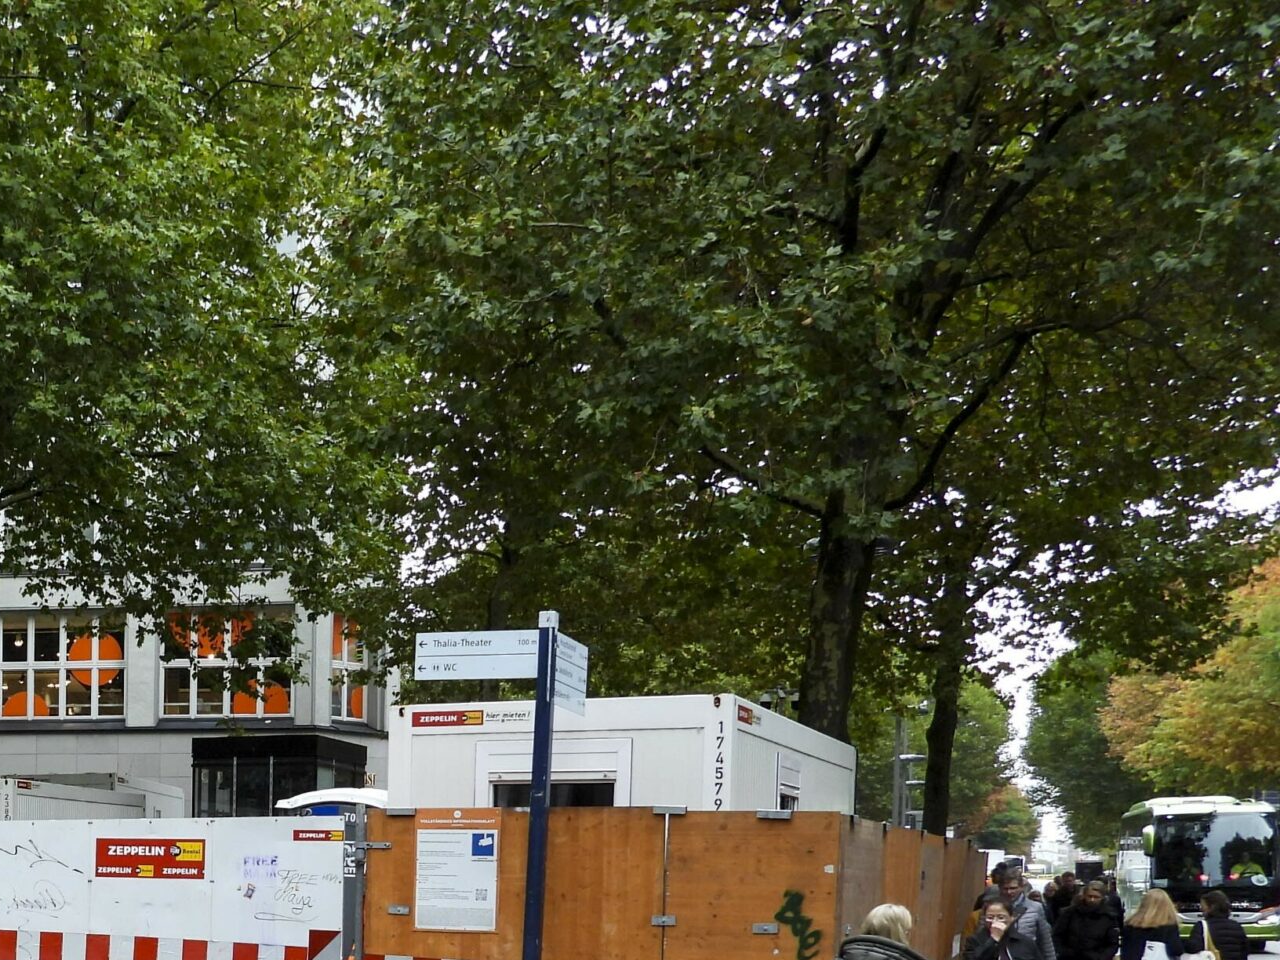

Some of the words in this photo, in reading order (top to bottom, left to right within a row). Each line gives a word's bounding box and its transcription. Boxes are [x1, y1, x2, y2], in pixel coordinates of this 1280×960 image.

[433, 638, 492, 648] Thalia-Theater
[443, 663, 457, 671] WC
[419, 714, 457, 723] ZEPPELIN
[485, 711, 501, 719] hier
[714, 720, 725, 813] 174579
[107, 845, 165, 856] ZEPPELIN
[97, 866, 132, 874] ZEPPELIN
[162, 867, 198, 875] ZEPPELIN
